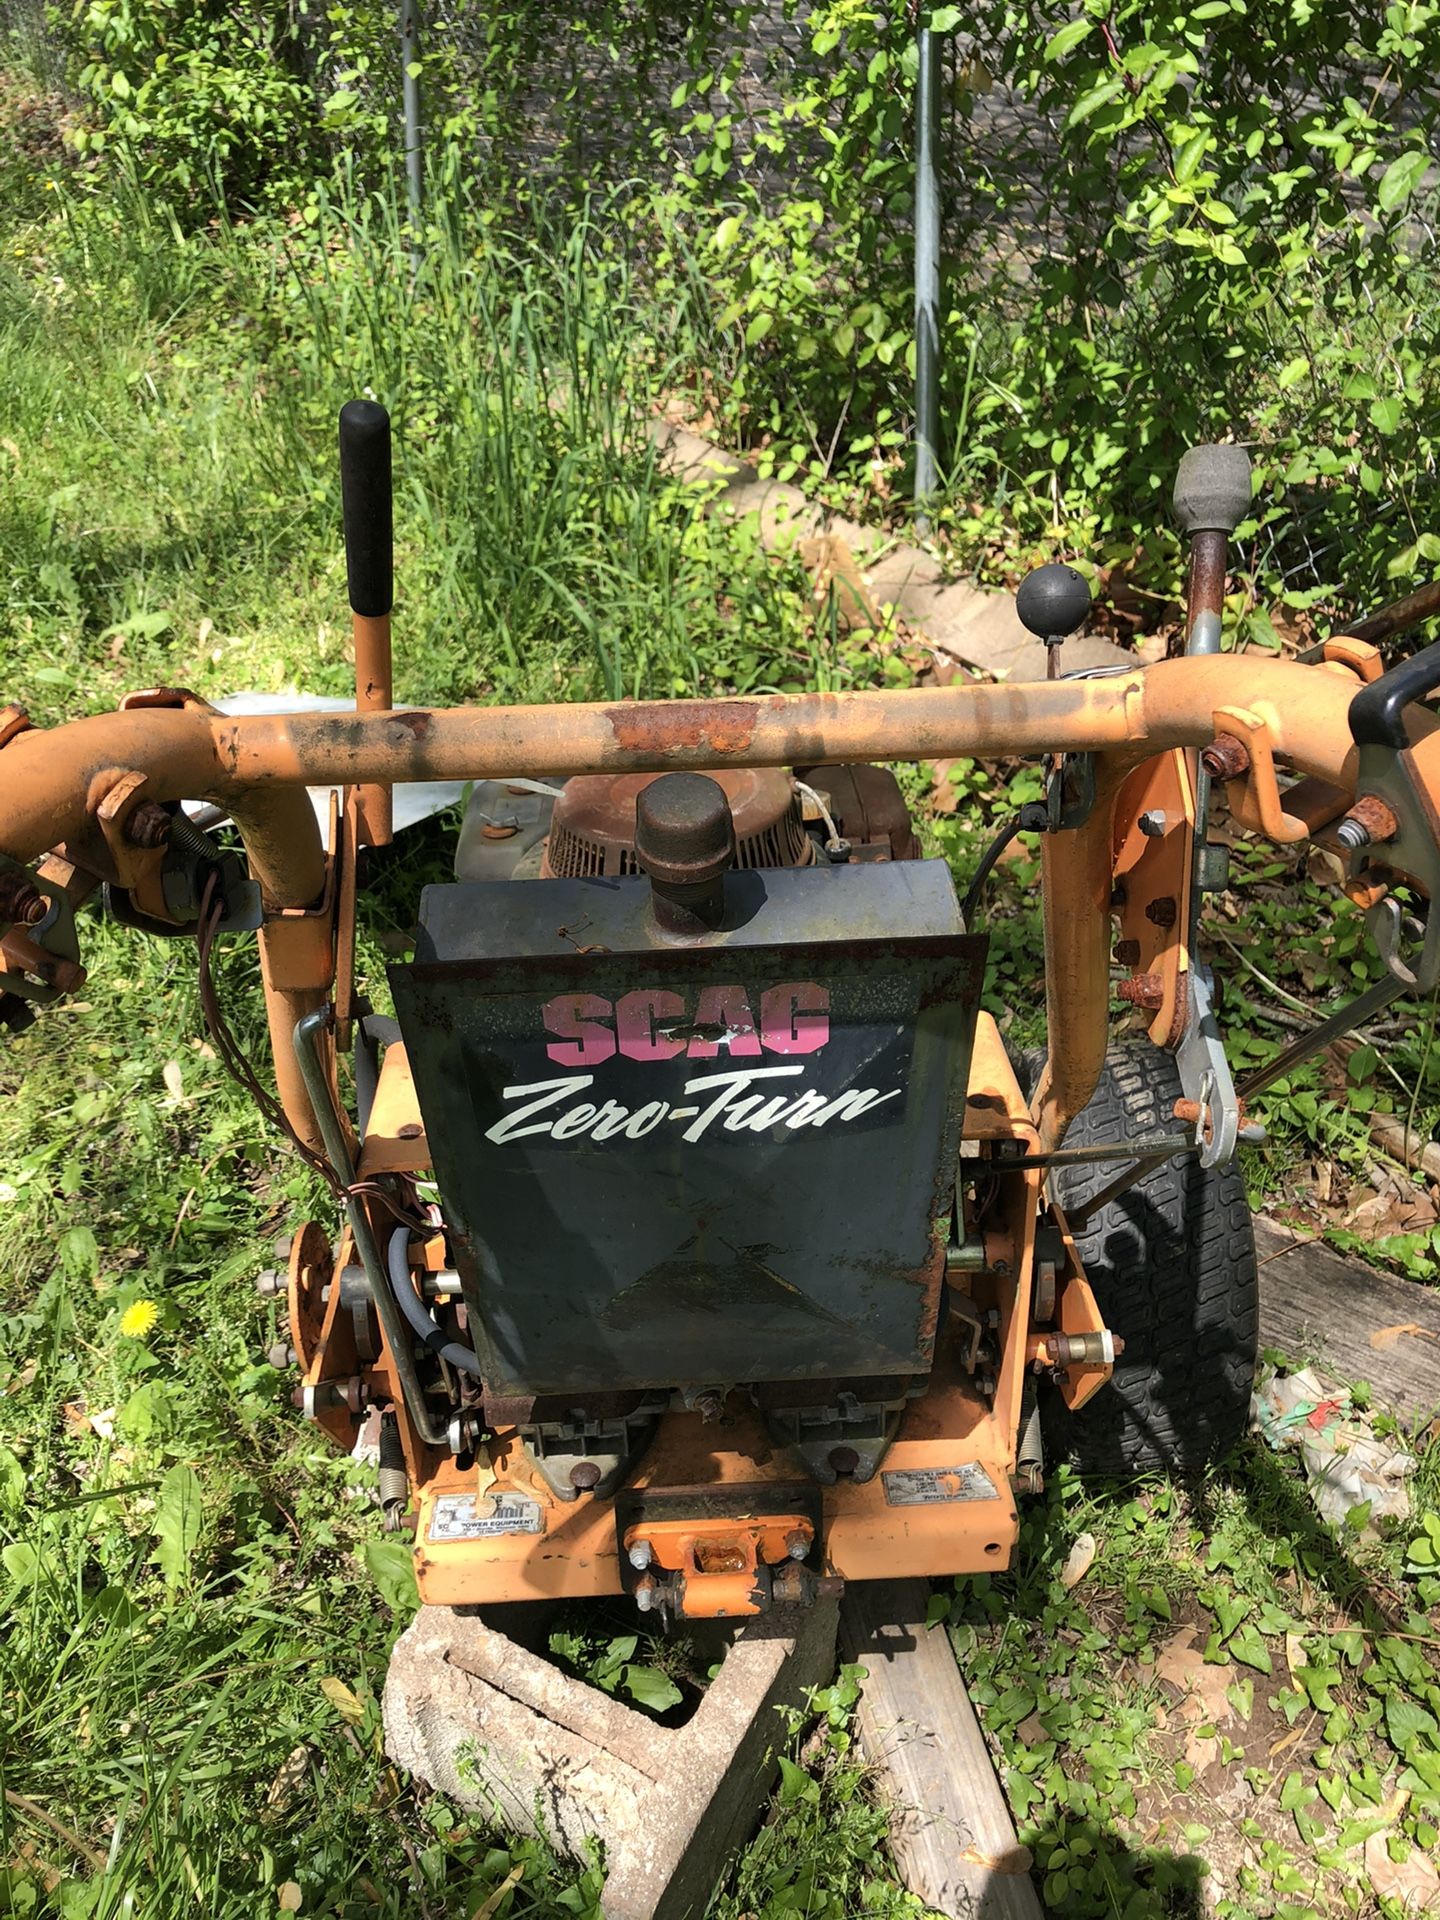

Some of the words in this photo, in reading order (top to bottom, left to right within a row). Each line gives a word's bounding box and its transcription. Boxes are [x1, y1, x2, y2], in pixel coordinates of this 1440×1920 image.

[541, 981, 830, 1067] SCAG
[484, 1065, 901, 1145] Zero-Turn
[490, 1519, 535, 1527] EQUIPMENT
